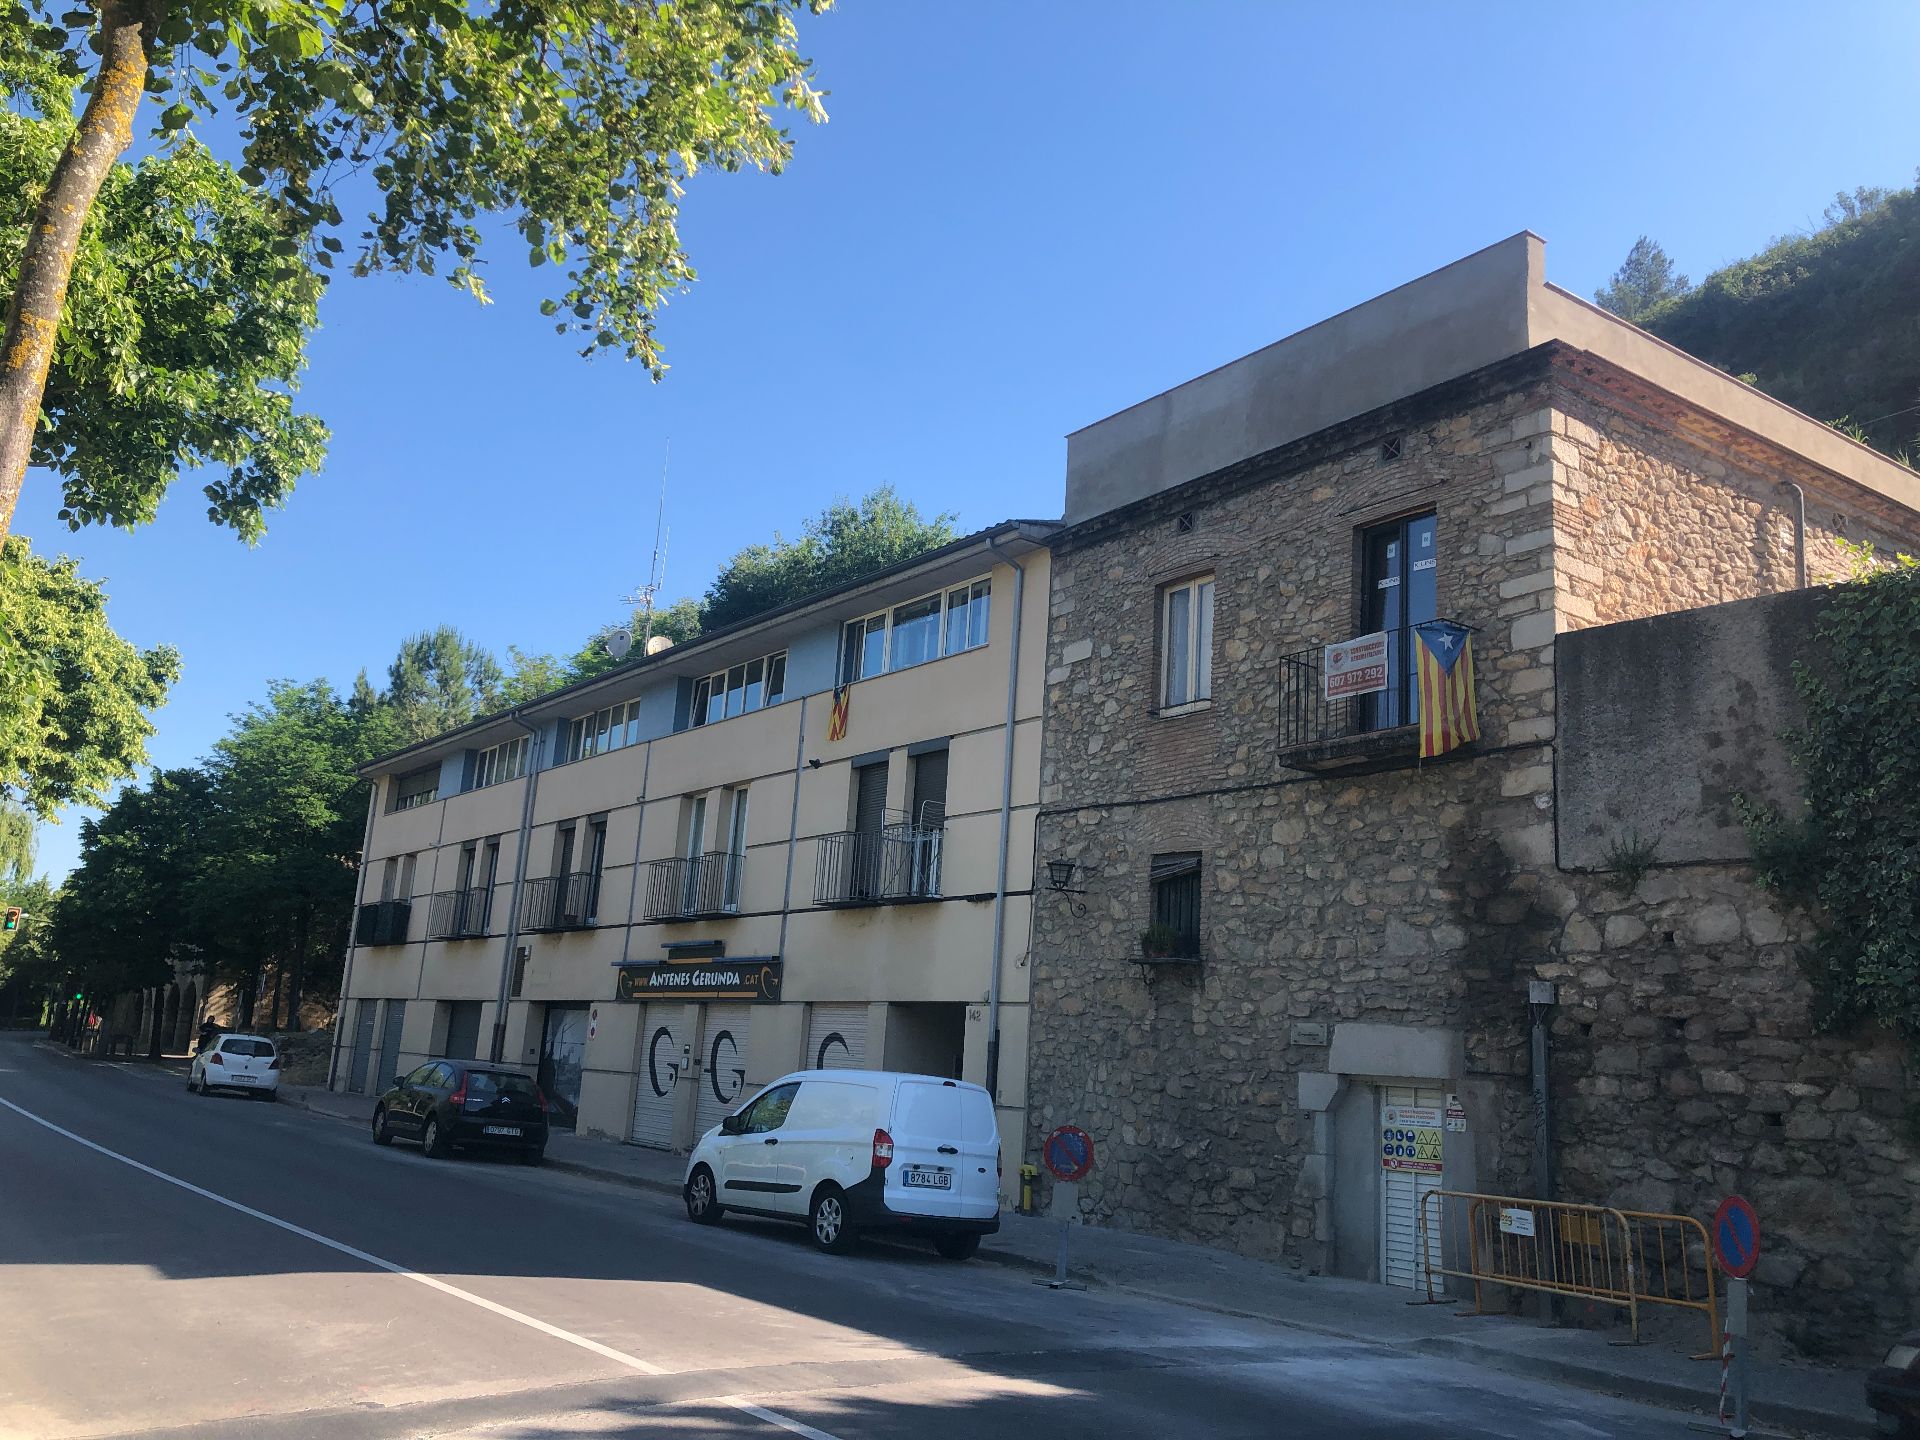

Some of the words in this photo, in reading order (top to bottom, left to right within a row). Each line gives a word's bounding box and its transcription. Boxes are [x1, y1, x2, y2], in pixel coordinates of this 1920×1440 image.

[1329, 675, 1345, 688] 607
[1346, 671, 1363, 684] 972
[1364, 667, 1383, 680] 292
[649, 970, 690, 987] ANTENES
[692, 969, 740, 986] GERUNDA
[910, 1172, 931, 1184] 8784
[933, 1174, 949, 1186] LGB
